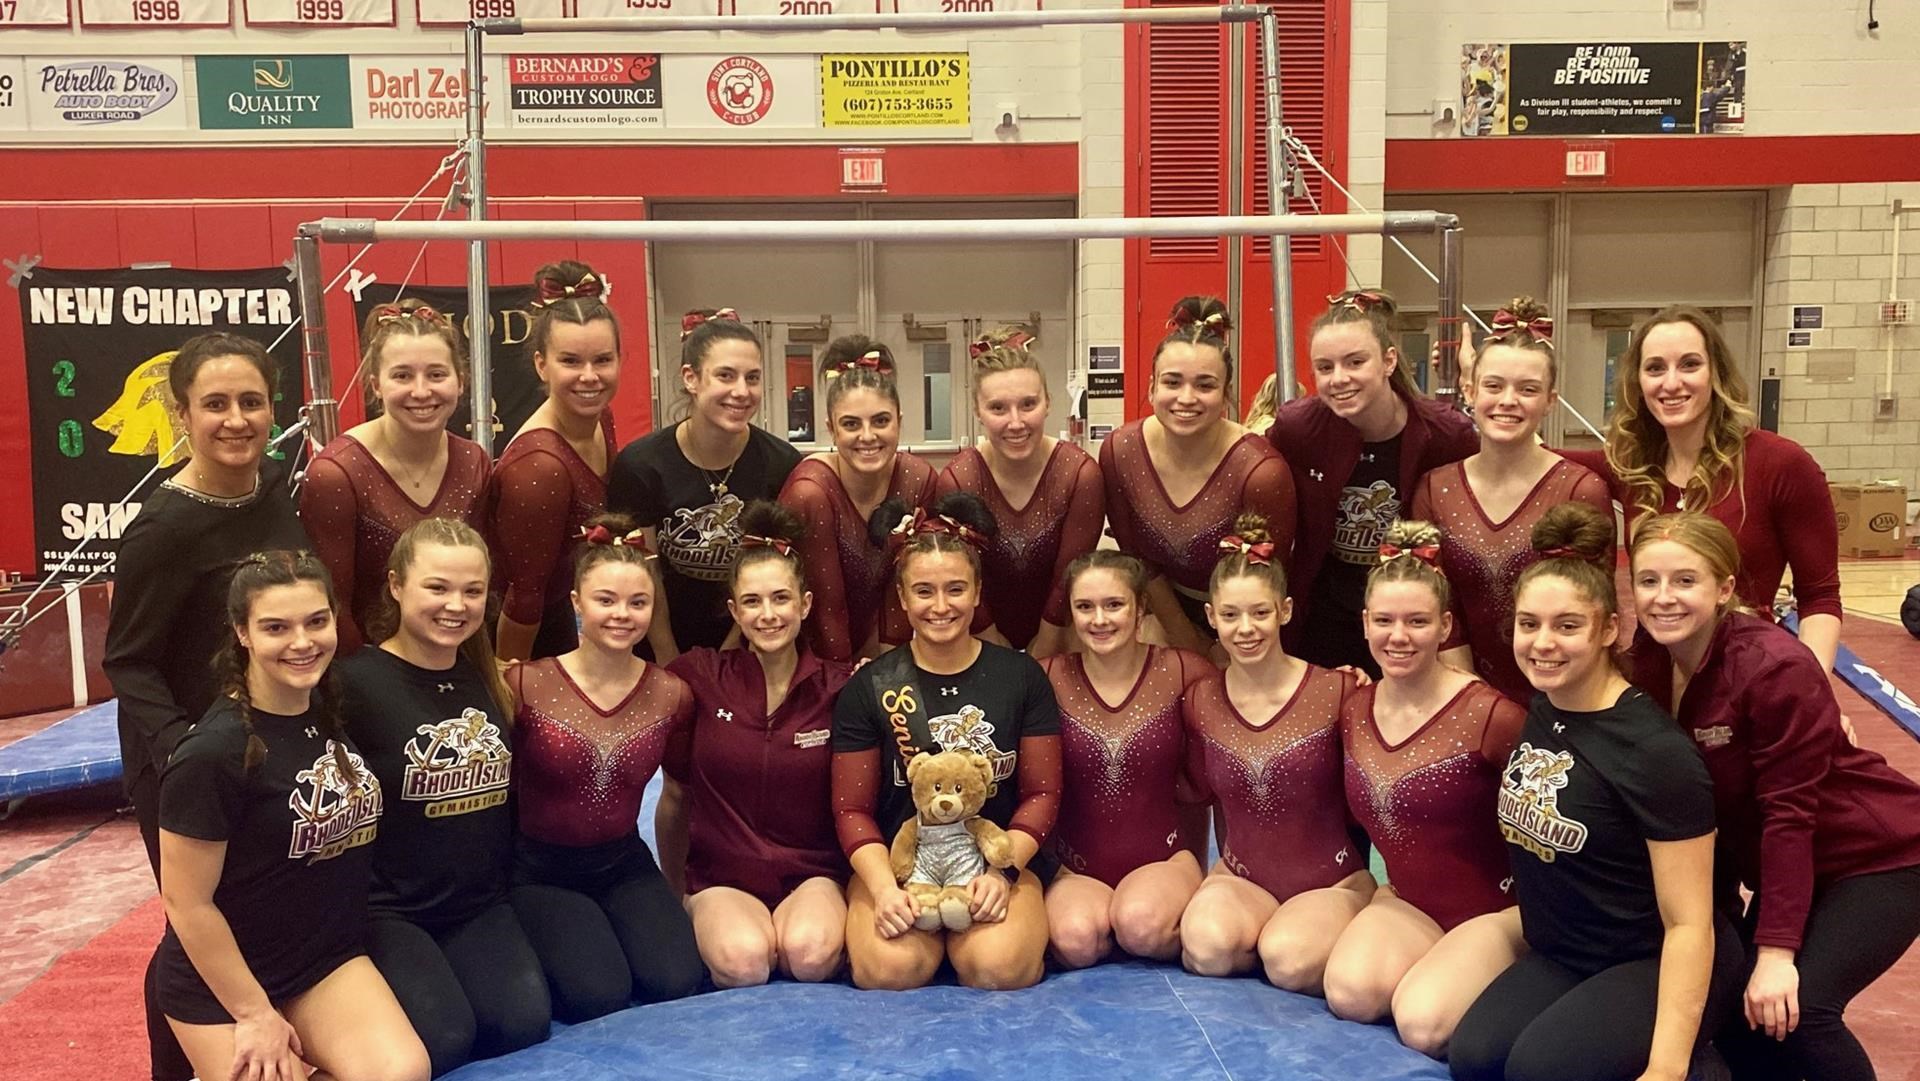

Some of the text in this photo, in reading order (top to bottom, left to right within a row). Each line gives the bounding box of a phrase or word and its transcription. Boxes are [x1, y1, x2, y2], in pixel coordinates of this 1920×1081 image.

[132, 0, 180, 20] 1998
[297, 0, 344, 20] 1999
[469, 0, 515, 18] 1999
[516, 57, 624, 74] BERNARD'S
[711, 61, 730, 82] SUNY
[730, 58, 769, 82] CORTLAND
[831, 59, 961, 78] PONTILLO'S
[41, 65, 170, 92] Petrella Bros.
[367, 68, 420, 98] Darl
[522, 73, 619, 82] CUSTOM LOGO
[898, 79, 950, 87] RESTAURANT
[1553, 68, 1651, 85] BE POSITIVE
[54, 95, 155, 108] AUTO BODY
[228, 92, 320, 115] QUALITY
[517, 89, 656, 105] TROPHY SOURCE
[843, 97, 953, 112] (607)753-3655
[1531, 98, 1560, 106] Division
[1571, 97, 1631, 107] student-athletes,
[1645, 97, 1672, 106] commit
[1674, 97, 1682, 106] to
[261, 115, 292, 124] INN
[369, 101, 490, 119] PHOTOGRAPY
[722, 111, 760, 124] C-CLUB
[1537, 107, 1664, 117] fair play, responsibility and respect.
[518, 115, 658, 126] bernardscustomlogo.com
[851, 161, 877, 180] EXIT
[1576, 153, 1601, 172] EXIT
[30, 286, 292, 325] NEW CHAPTER
[52, 360, 77, 397] 2
[59, 420, 84, 458] 0
[409, 768, 472, 795] RHODE
[429, 792, 506, 815] GYMNASTICS
[298, 807, 353, 852] RHODE
